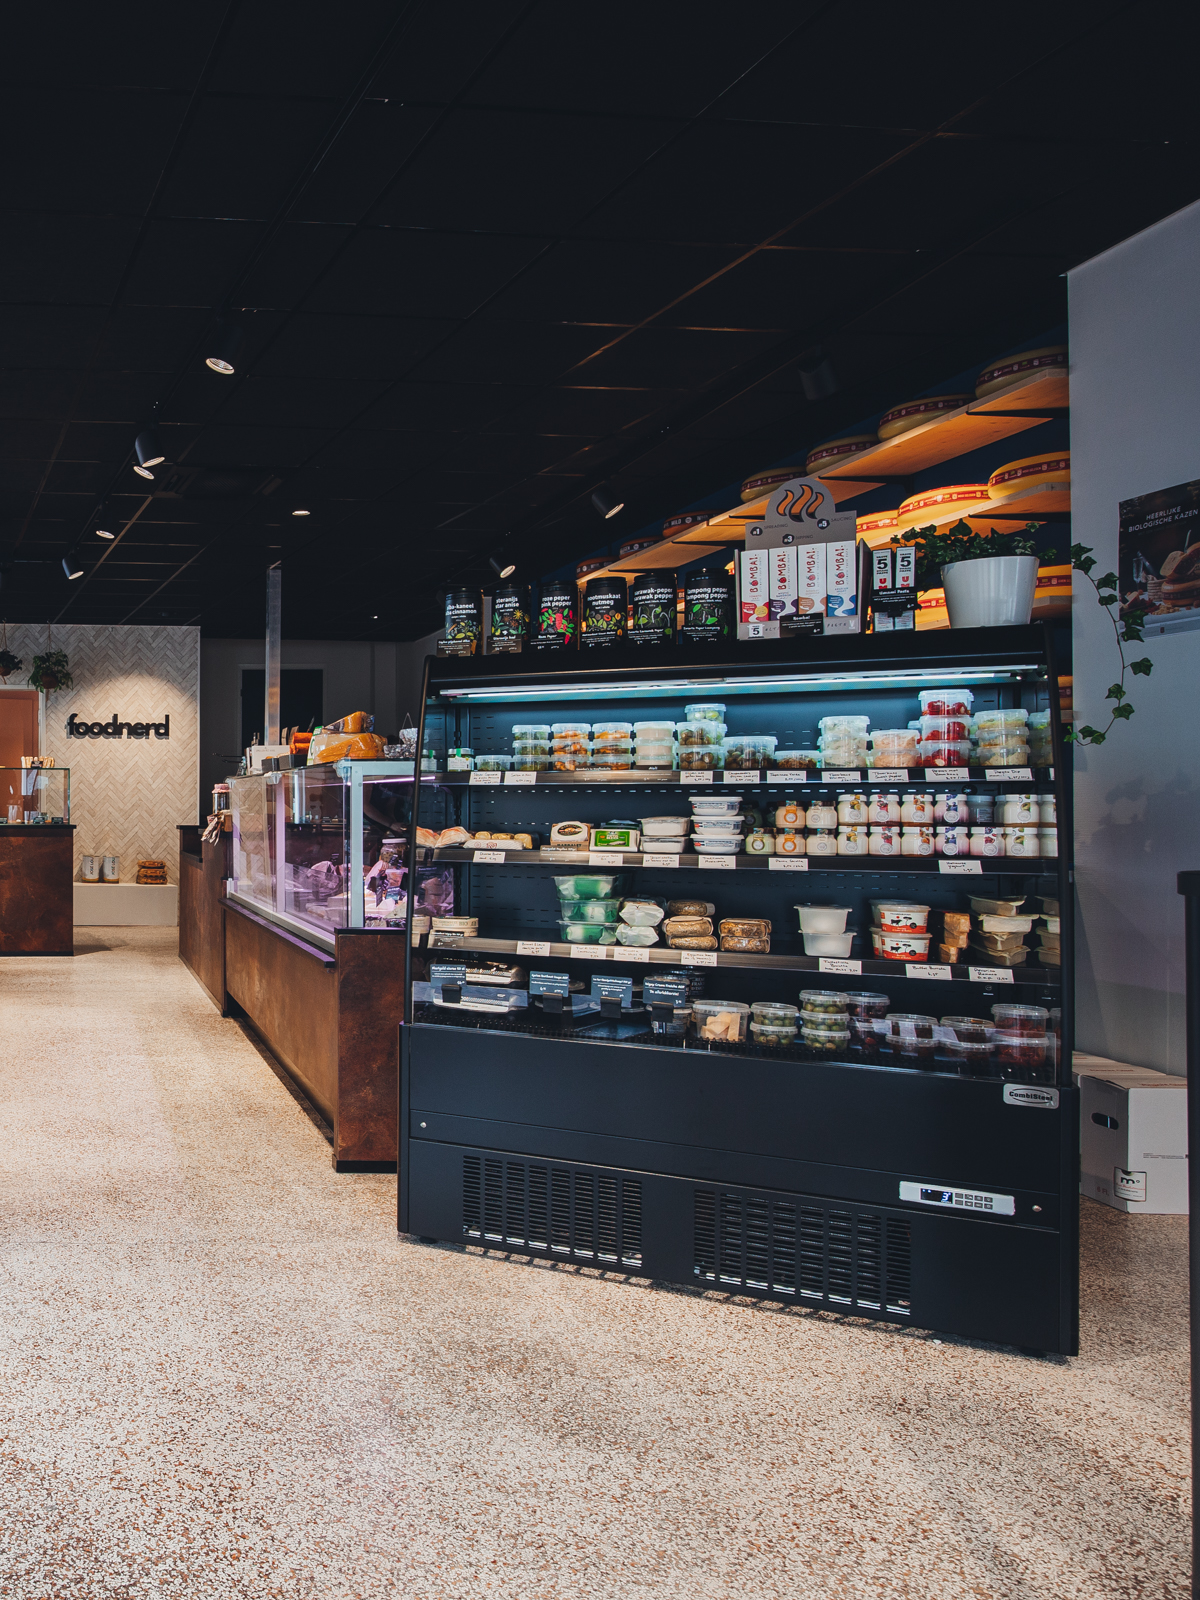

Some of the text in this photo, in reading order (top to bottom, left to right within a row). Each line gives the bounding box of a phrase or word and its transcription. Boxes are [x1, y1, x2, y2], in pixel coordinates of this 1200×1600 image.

[1146, 505, 1181, 520] HEERLIJKE
[1128, 509, 1199, 533] BIOLOGISCHE KAZEN
[876, 558, 888, 570] 5
[900, 556, 911, 568] 5
[554, 595, 571, 603] peper
[654, 593, 674, 601] pepper
[710, 593, 729, 601] pepper
[592, 599, 615, 607] nutmeg
[752, 627, 760, 636] 5
[67, 712, 170, 740] foodnerd
[1009, 1091, 1054, 1102] CombiSteel
